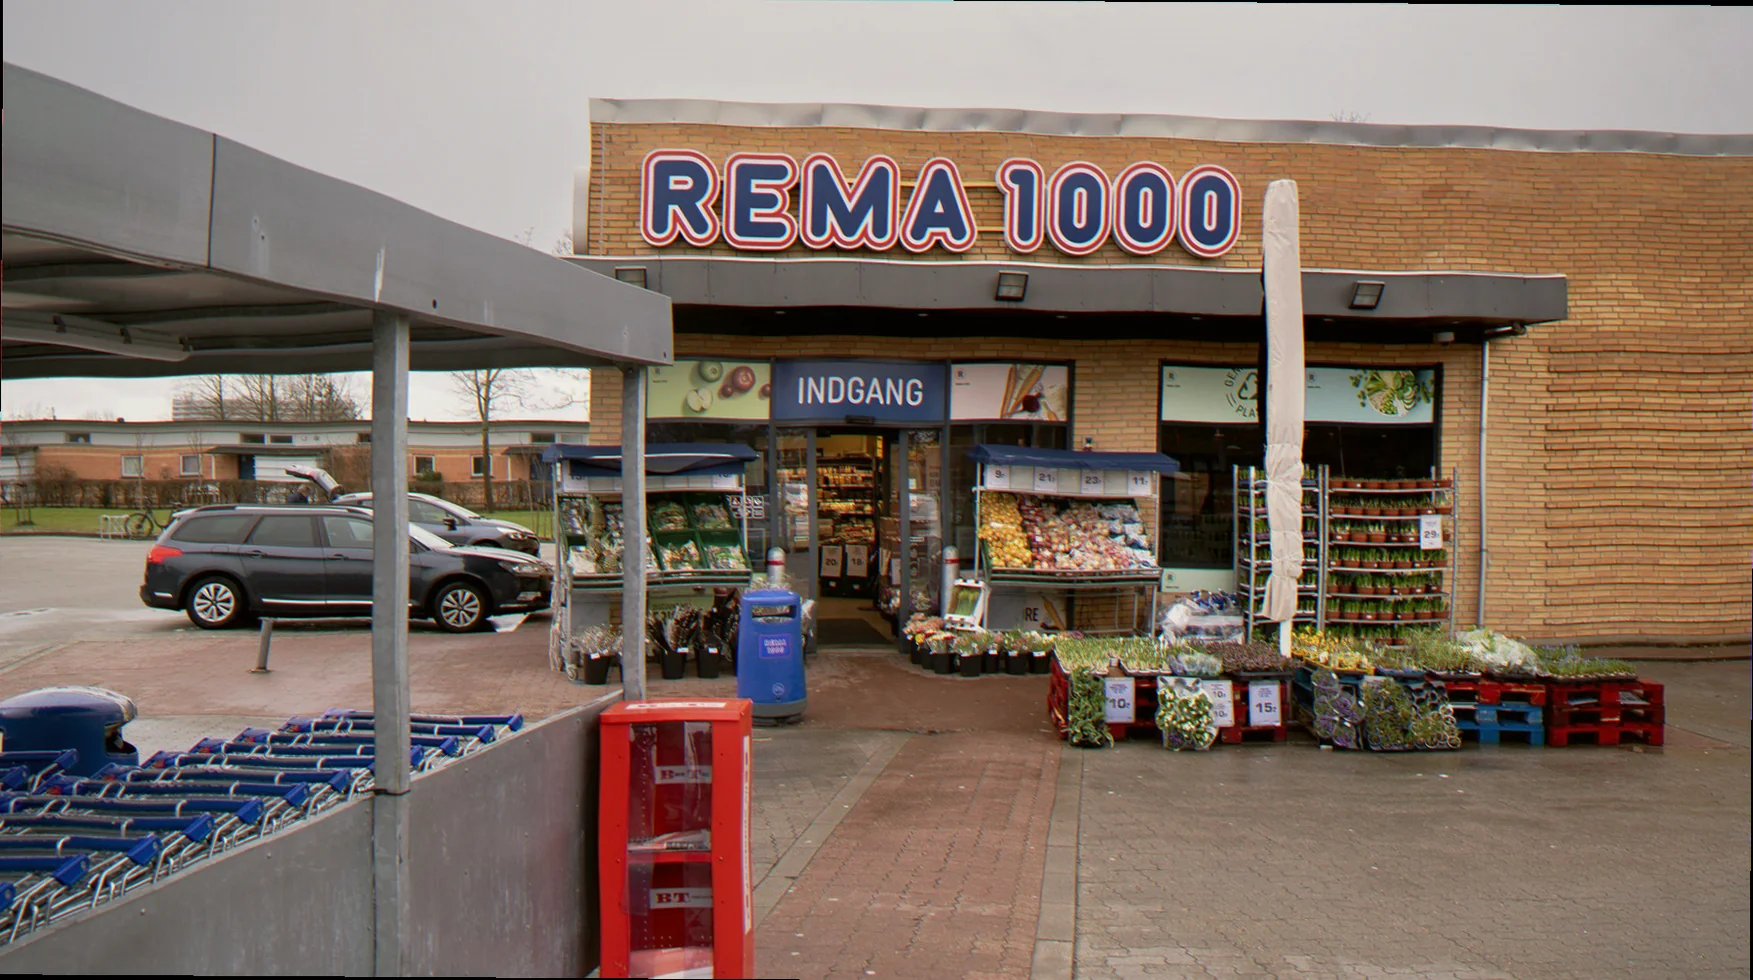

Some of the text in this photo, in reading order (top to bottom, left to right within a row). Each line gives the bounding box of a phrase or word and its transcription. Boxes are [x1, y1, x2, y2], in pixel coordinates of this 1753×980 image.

[641, 147, 1242, 258] REMA 1000
[797, 376, 924, 407] INDGANG
[1235, 404, 1256, 418] PLA
[656, 891, 690, 904] BT
